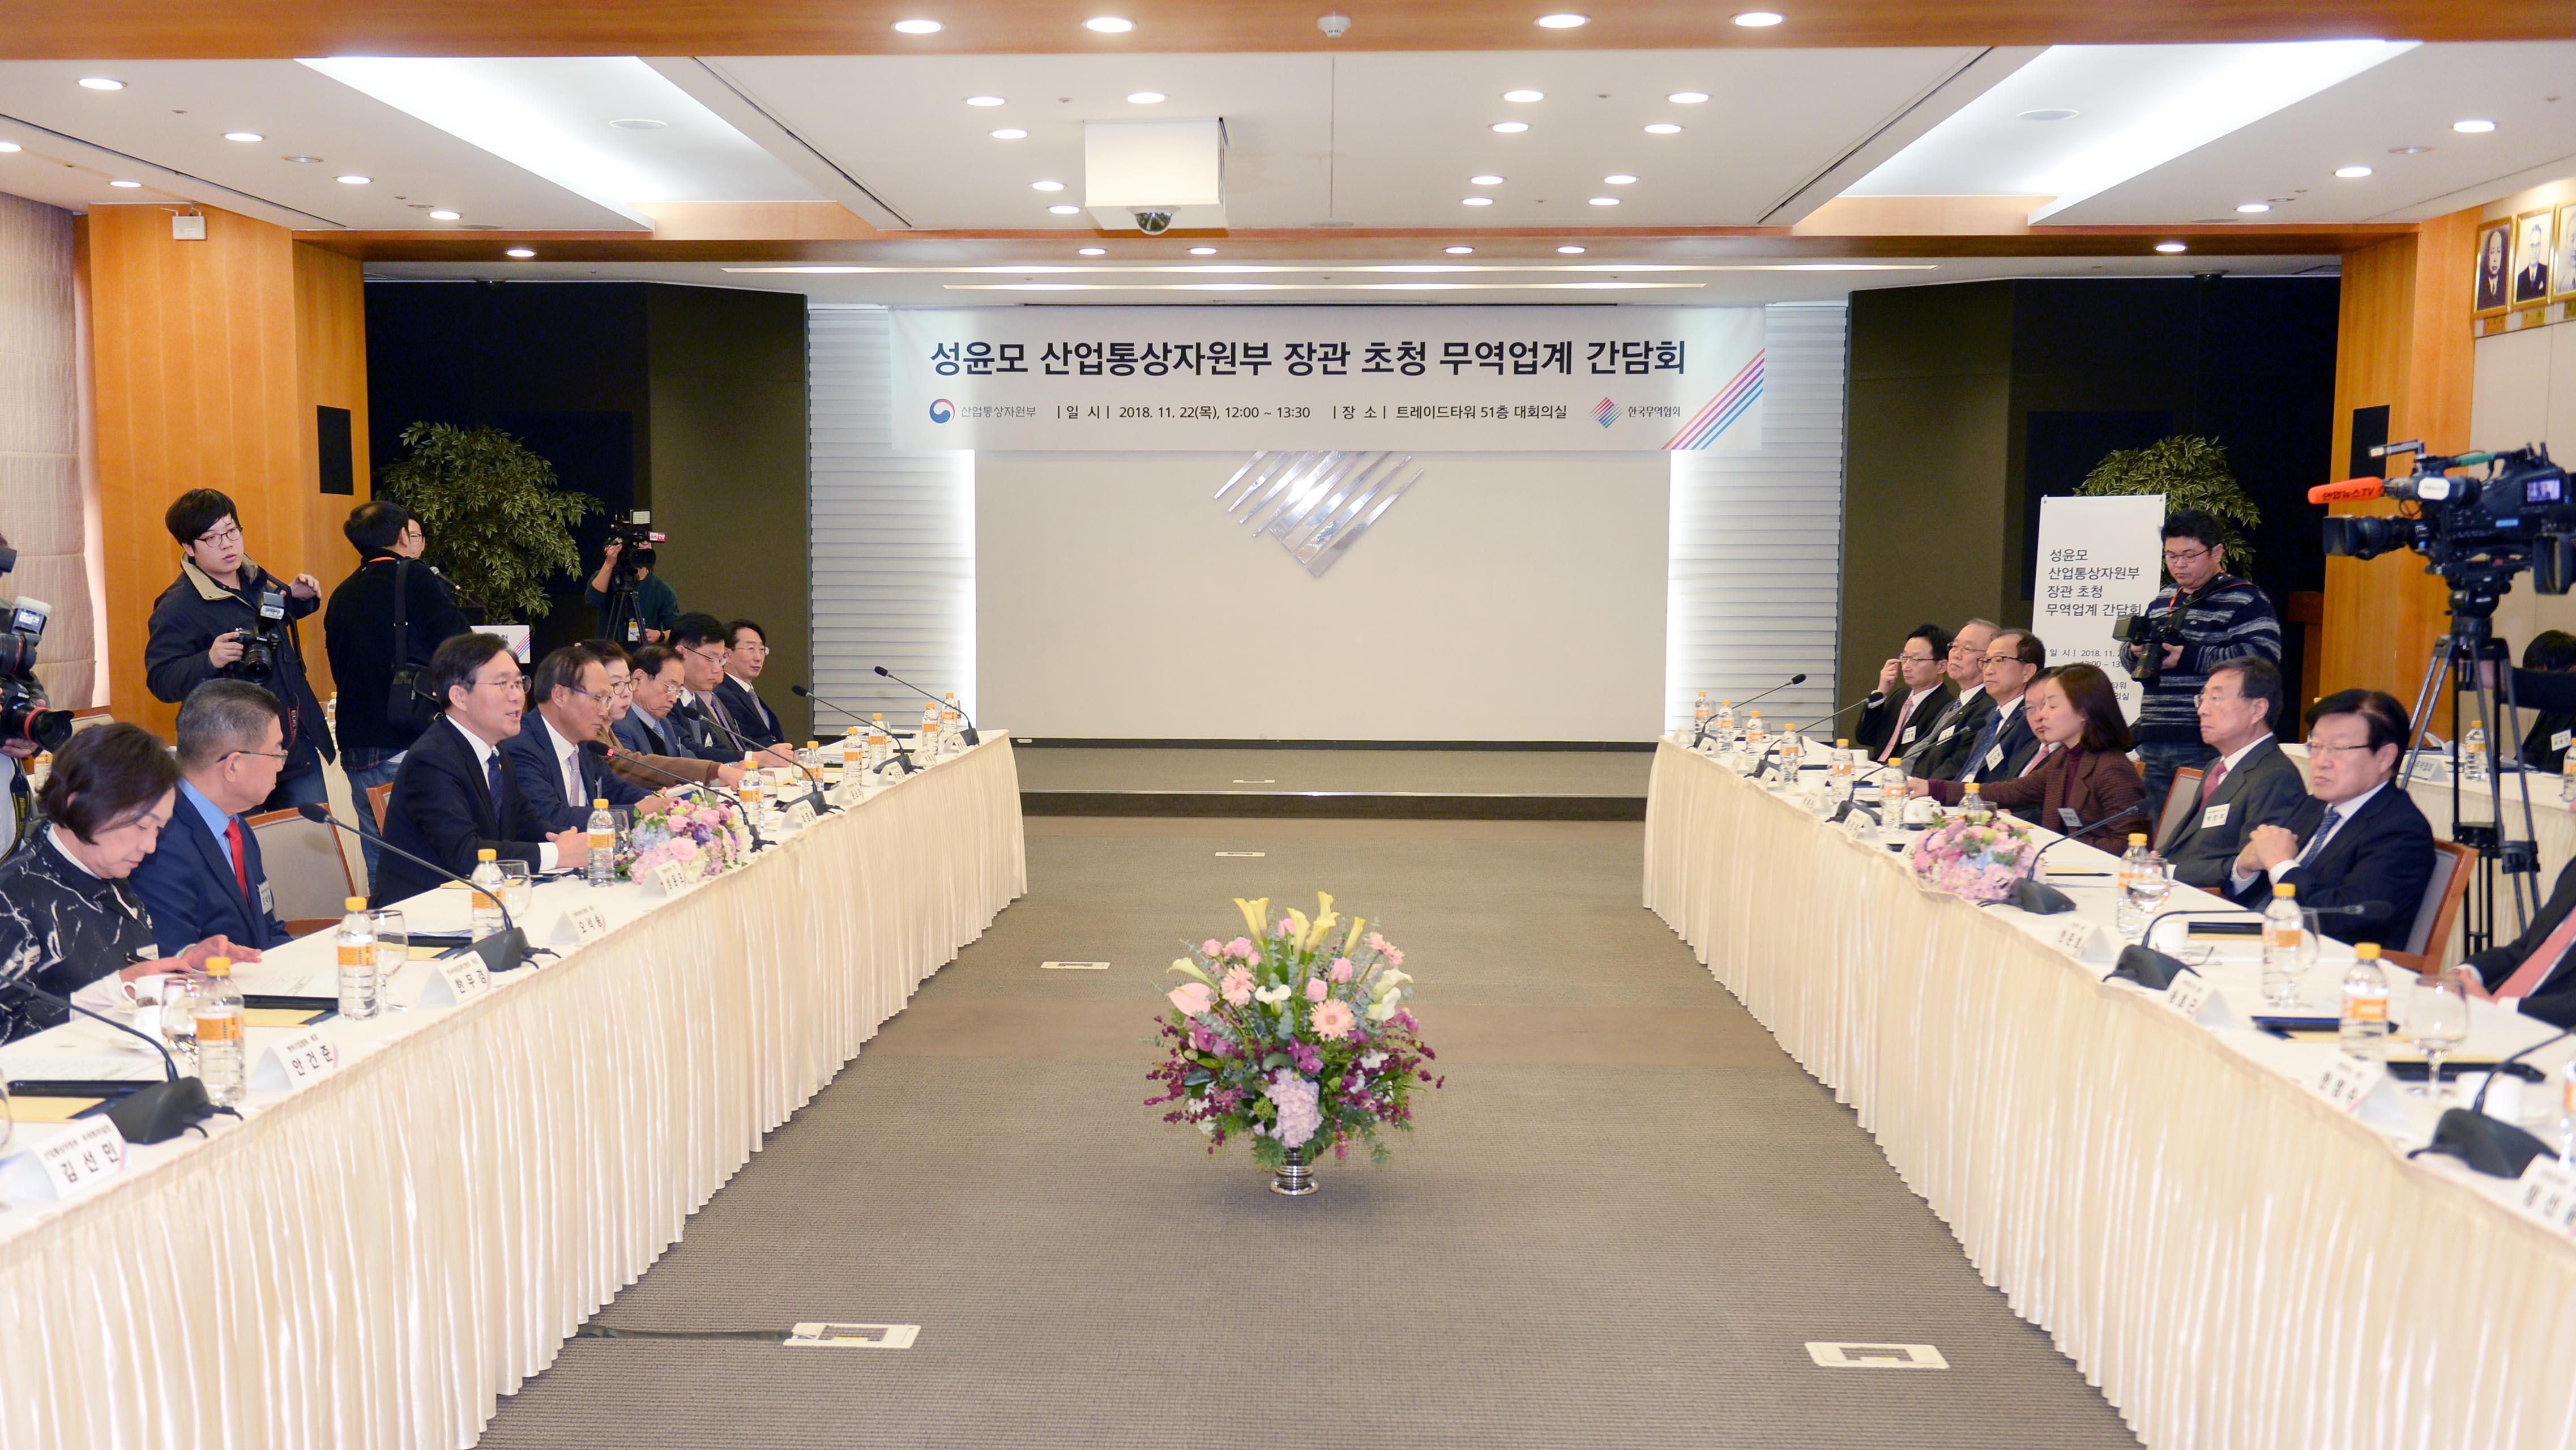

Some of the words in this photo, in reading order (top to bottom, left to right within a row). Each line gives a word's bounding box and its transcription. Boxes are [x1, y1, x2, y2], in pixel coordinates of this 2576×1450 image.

[930, 341, 1028, 376] 성윤모
[1040, 341, 1272, 377] 산업통상자원부
[1283, 342, 1351, 377] 장관
[1361, 341, 1426, 377] 초청
[1439, 340, 1573, 376] 무역업계
[1586, 340, 1685, 375] 간담회
[961, 406, 1037, 418] 산업통상자원부
[1119, 406, 1153, 419] 2018.
[1158, 406, 1175, 419] 11.
[1180, 406, 1220, 420] 22(목),
[1225, 406, 1259, 419] 12:00
[1277, 407, 1310, 419] 13:30
[1395, 404, 1476, 420] 트레이드타워
[1480, 404, 1510, 420] 51층
[1514, 404, 1567, 420] 대회의실
[1628, 406, 1681, 418] 한국무역협회
[2049, 549, 2088, 562] 성윤모
[2048, 566, 2141, 581] 산업통상자원부
[2047, 585, 2073, 599] 장관
[2077, 585, 2103, 599] 초청
[2045, 603, 2098, 617] 무역업계
[2102, 603, 2142, 617] 간담회
